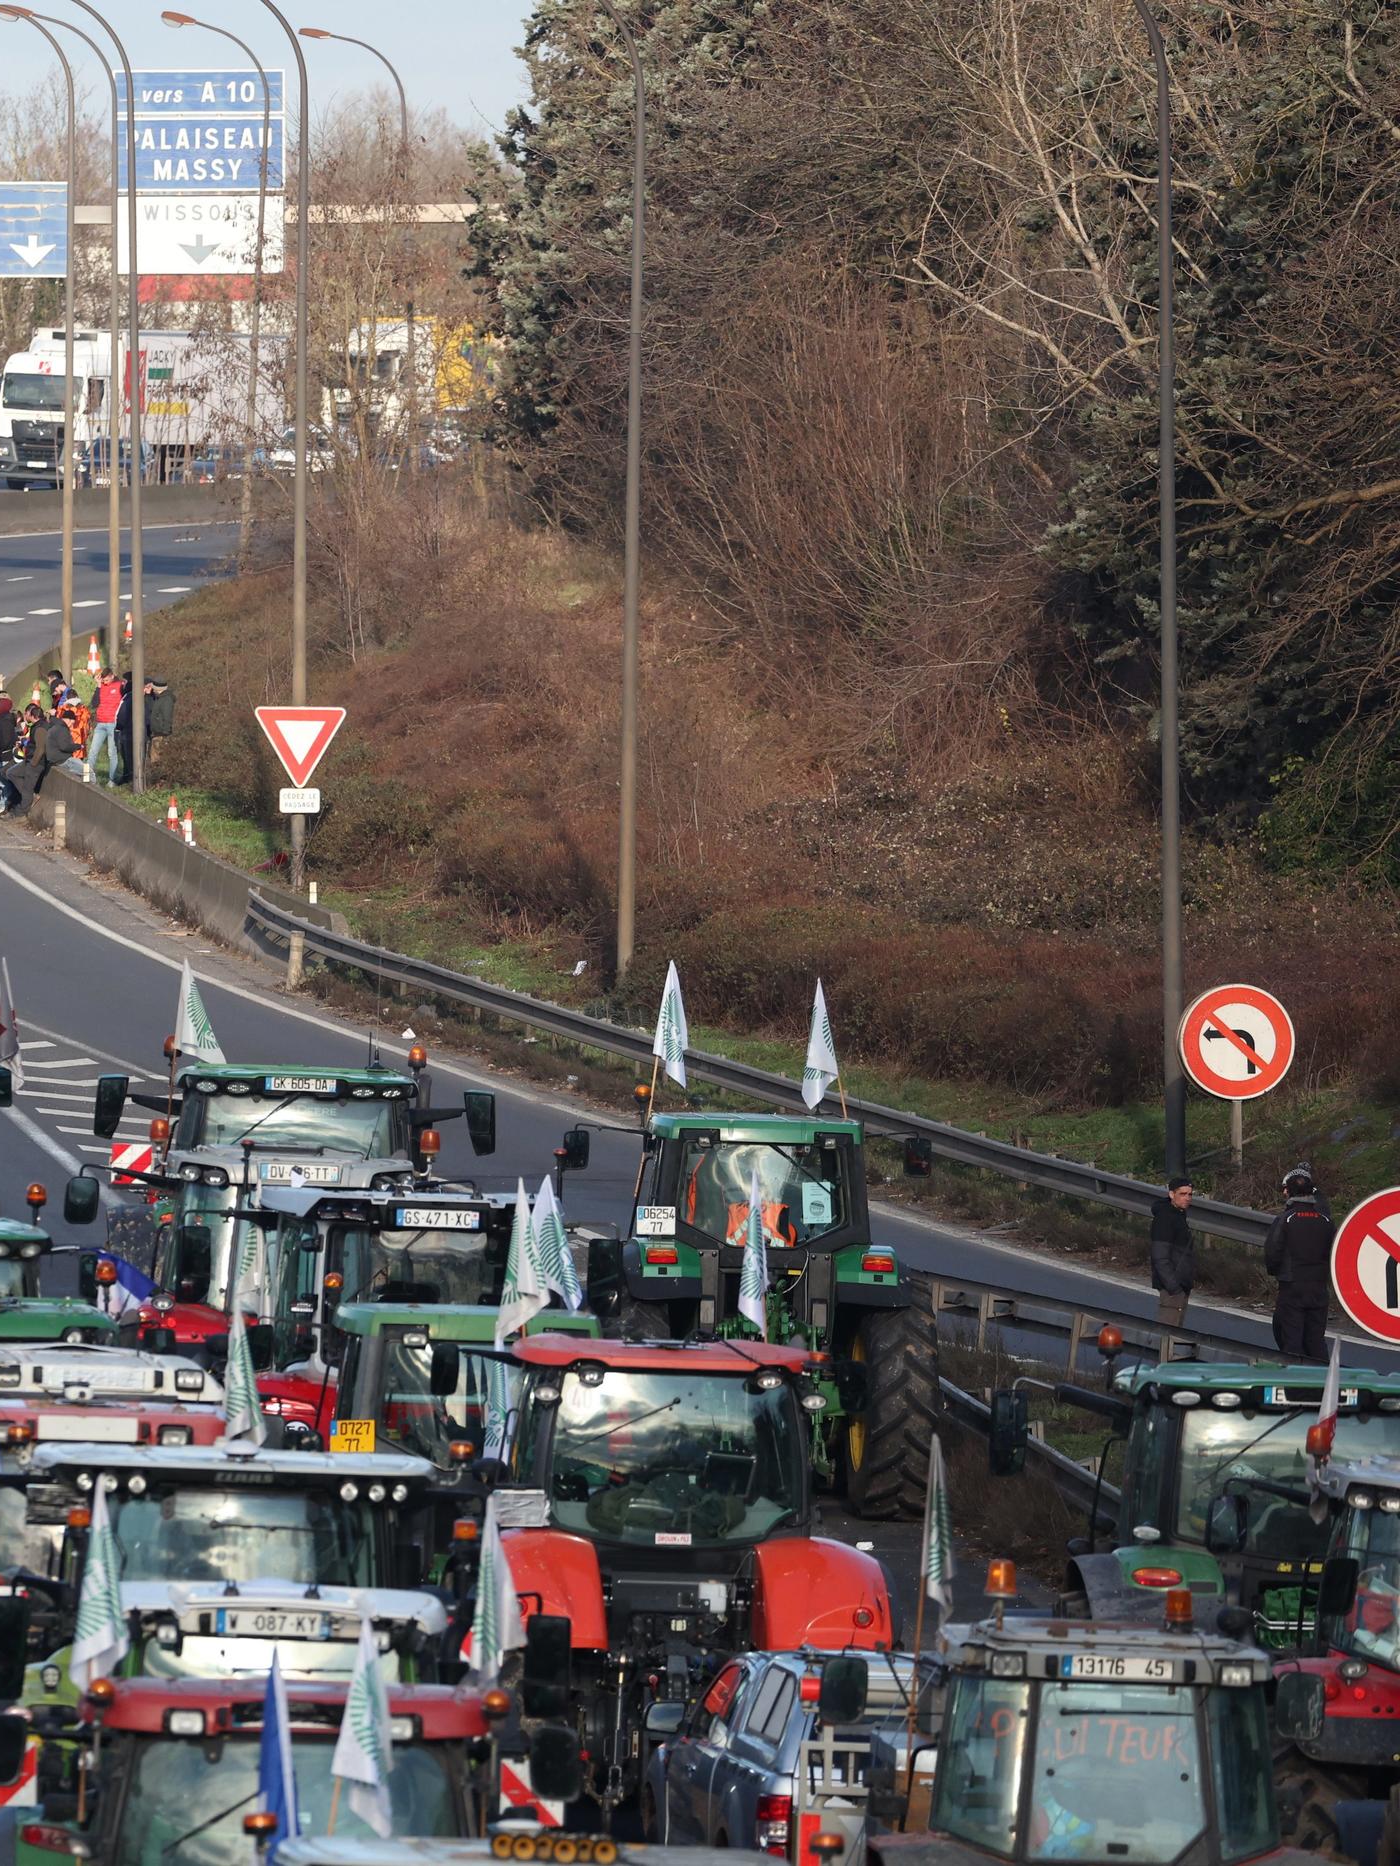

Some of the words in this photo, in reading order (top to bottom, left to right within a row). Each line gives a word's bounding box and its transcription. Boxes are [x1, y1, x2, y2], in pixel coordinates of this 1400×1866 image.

[142, 89, 184, 104] vers
[200, 81, 216, 103] A
[226, 81, 256, 103] 10
[153, 158, 243, 181] MASSY
[144, 204, 255, 222] WISSOUS
[404, 1211, 471, 1227] GS-471-XC
[643, 1207, 675, 1220] 06254
[650, 1221, 663, 1233] 77
[340, 1421, 371, 1436] 0727
[345, 1438, 360, 1452] 77
[1078, 1657, 1126, 1676] 13176
[1144, 1660, 1165, 1677] 45
